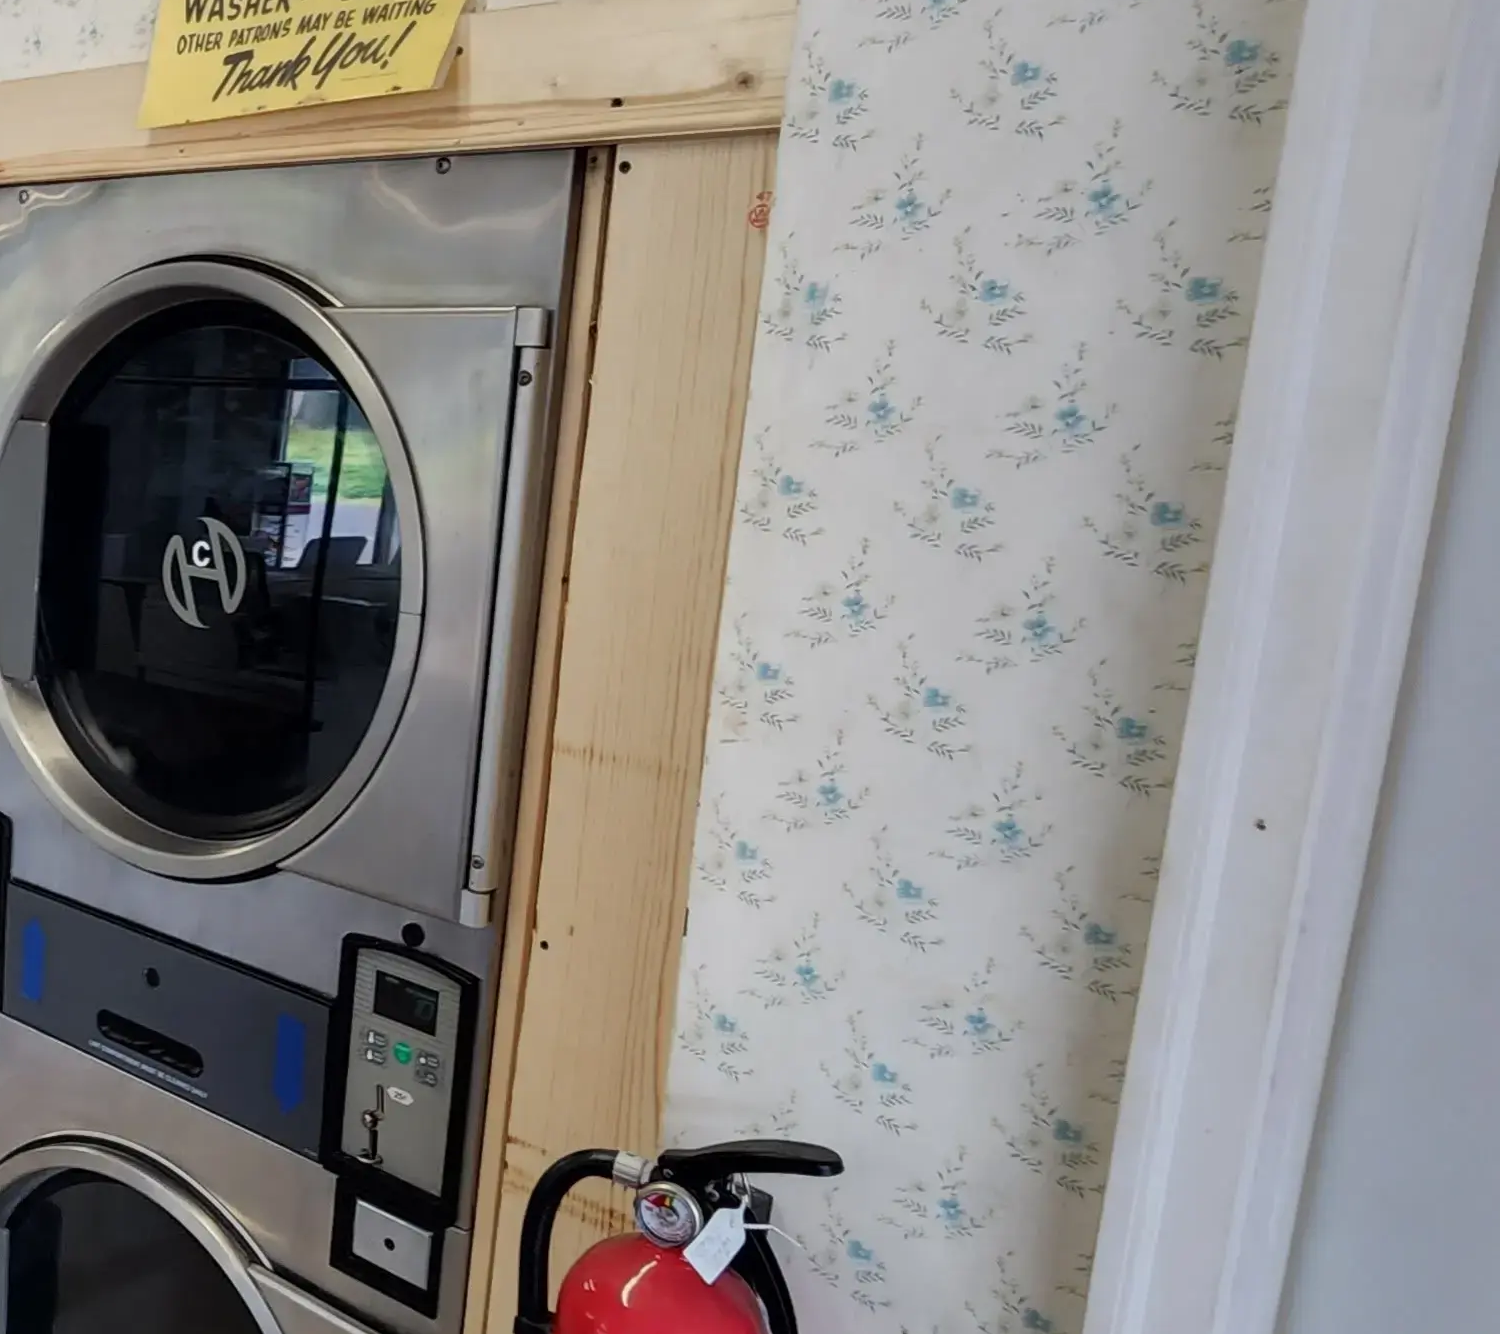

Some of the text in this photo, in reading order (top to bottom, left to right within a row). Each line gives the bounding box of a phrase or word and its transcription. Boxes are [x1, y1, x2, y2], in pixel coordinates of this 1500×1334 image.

[177, 31, 223, 54] OTHER
[228, 18, 292, 47] PATRONS
[296, 11, 332, 35] MAY
[333, 9, 356, 29] BE
[212, 20, 416, 102] Thank You!
[192, 540, 211, 567] C
